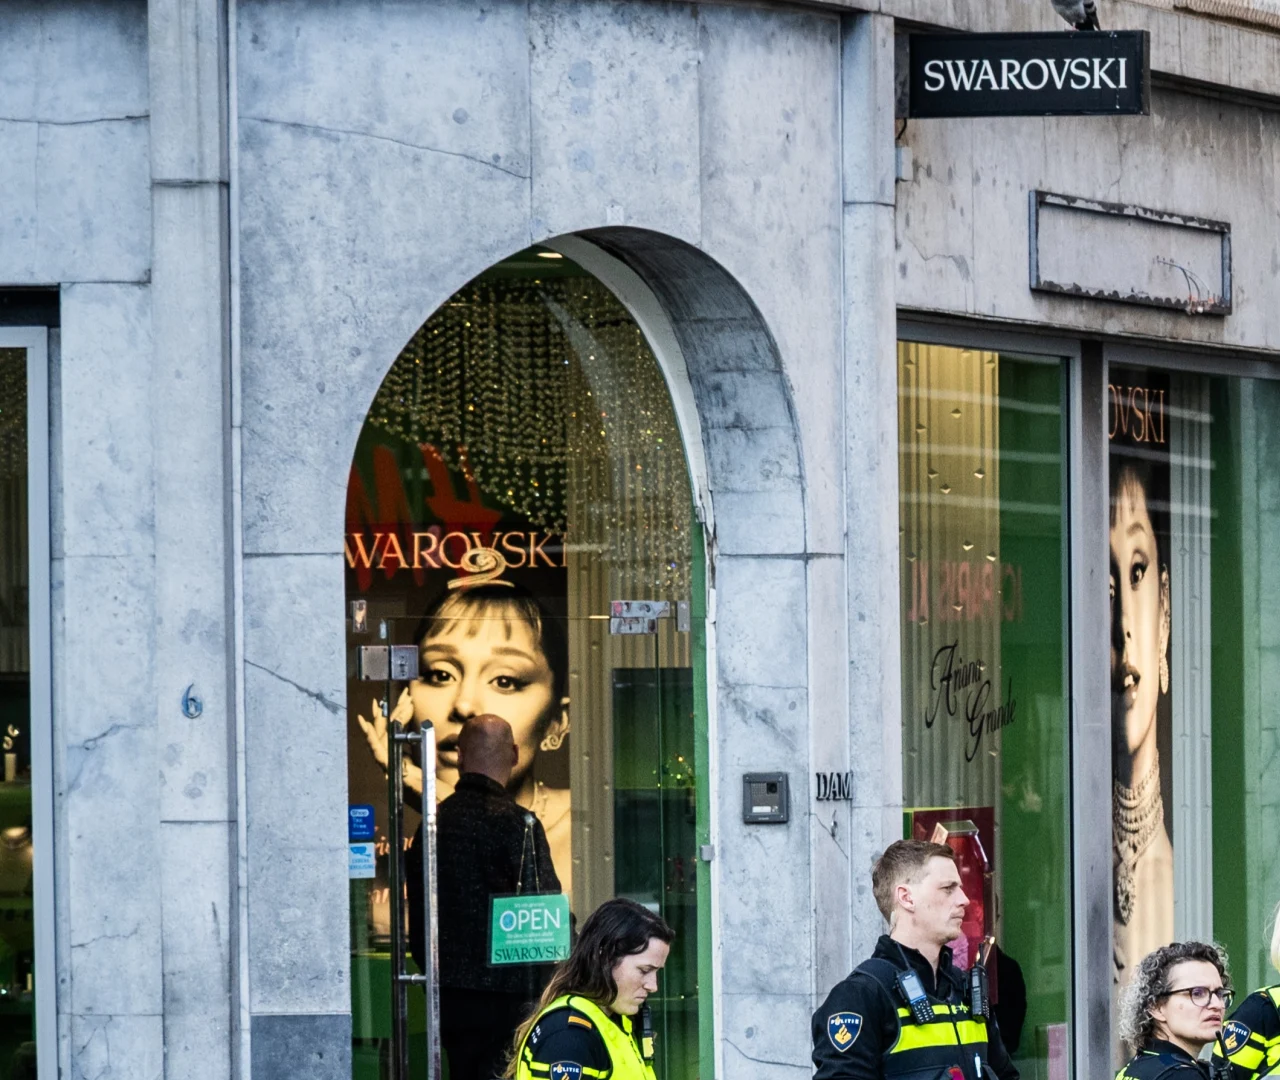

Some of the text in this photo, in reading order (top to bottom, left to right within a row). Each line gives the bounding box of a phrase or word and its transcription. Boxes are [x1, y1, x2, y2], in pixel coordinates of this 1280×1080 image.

[924, 57, 1128, 92] SWAROVSKI
[924, 639, 983, 728] Ariana
[181, 684, 204, 720] 6
[965, 680, 1017, 762] Grande
[816, 772, 854, 802] DAM
[500, 908, 561, 932] OPEN
[495, 946, 567, 961] SWAROVSKI
[830, 1016, 860, 1027] POLITIE
[1226, 1023, 1248, 1037] POLITIE
[552, 1063, 581, 1074] POLITIE
